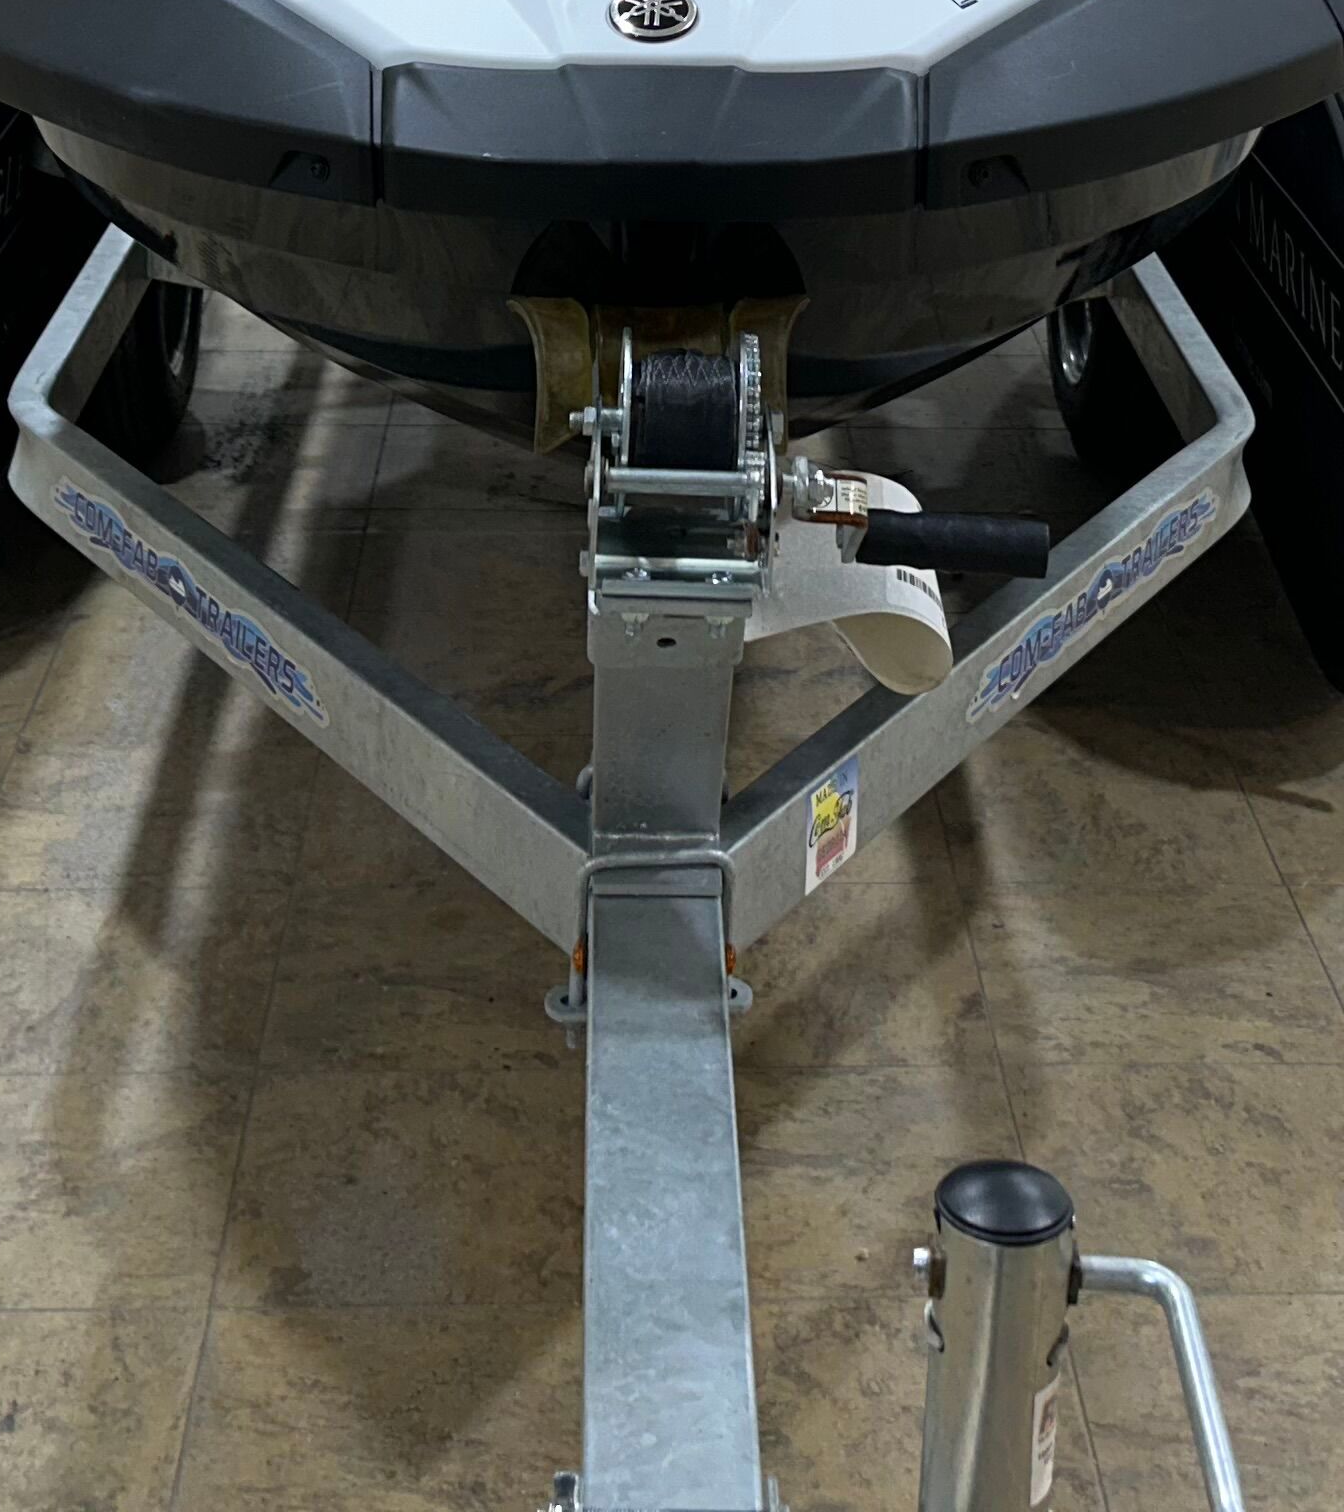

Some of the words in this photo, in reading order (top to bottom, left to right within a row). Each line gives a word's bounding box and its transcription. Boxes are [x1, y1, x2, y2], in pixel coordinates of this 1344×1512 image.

[1250, 181, 1343, 371] MARINE
[1121, 499, 1200, 587] TRAILERS
[194, 587, 297, 694] TRAILERS
